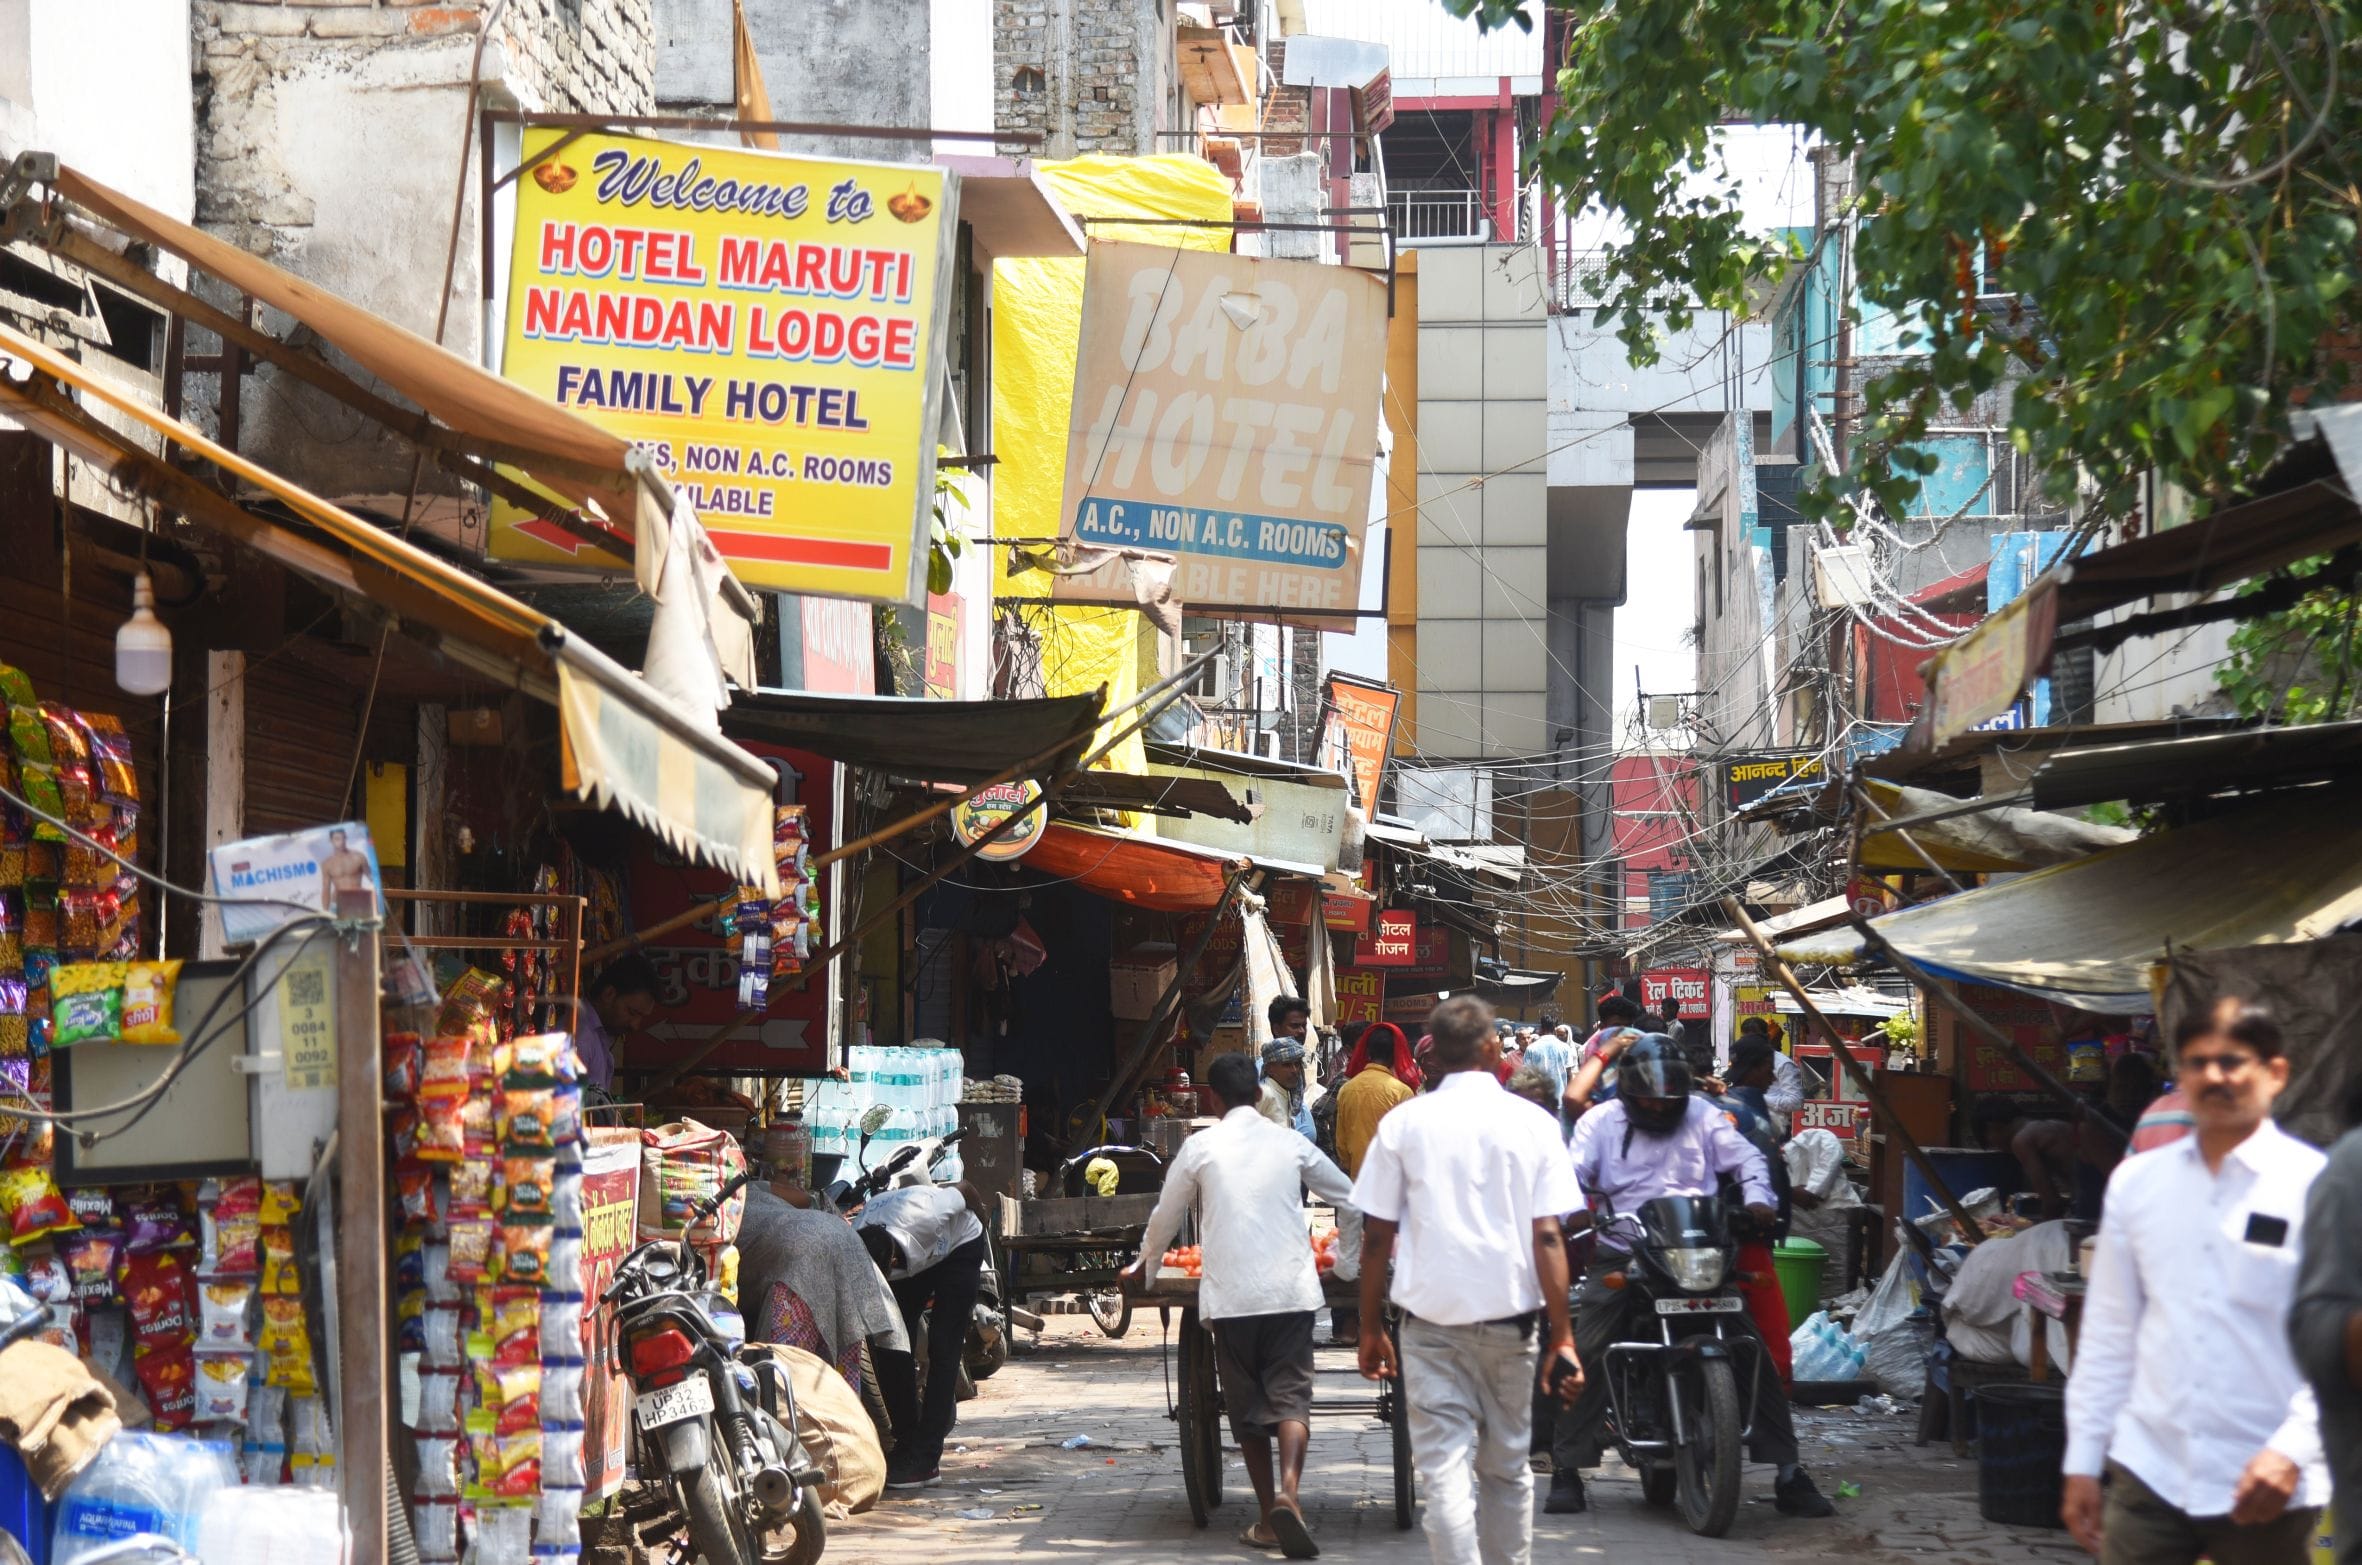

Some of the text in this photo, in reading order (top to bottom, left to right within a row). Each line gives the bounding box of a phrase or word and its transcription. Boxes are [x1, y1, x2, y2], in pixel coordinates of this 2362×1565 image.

[593, 151, 873, 224] Welcome to
[540, 222, 912, 302] HOTEL MARUTI
[523, 288, 917, 369] NANDAN LODGE
[556, 366, 869, 432] FAMILY HOTEL
[1081, 267, 1355, 514] BABA HOTEL
[685, 445, 740, 474] NON
[746, 451, 795, 479] A.C.
[803, 455, 893, 487] ROOMS
[1082, 502, 1341, 559] A.C., NON A.C. ROOMS
[1730, 761, 1787, 782] आनन्द
[231, 861, 318, 889] MACHISMO
[1644, 977, 1705, 1001] रेल टिकट
[305, 1007, 314, 1019] 3
[291, 1021, 326, 1035] 0084
[303, 1037, 317, 1047] 11
[70, 1198, 113, 1215] Mexilla
[139, 1314, 183, 1335] Doritos
[162, 1395, 194, 1413] oritos
[644, 1398, 709, 1428] HP3462
